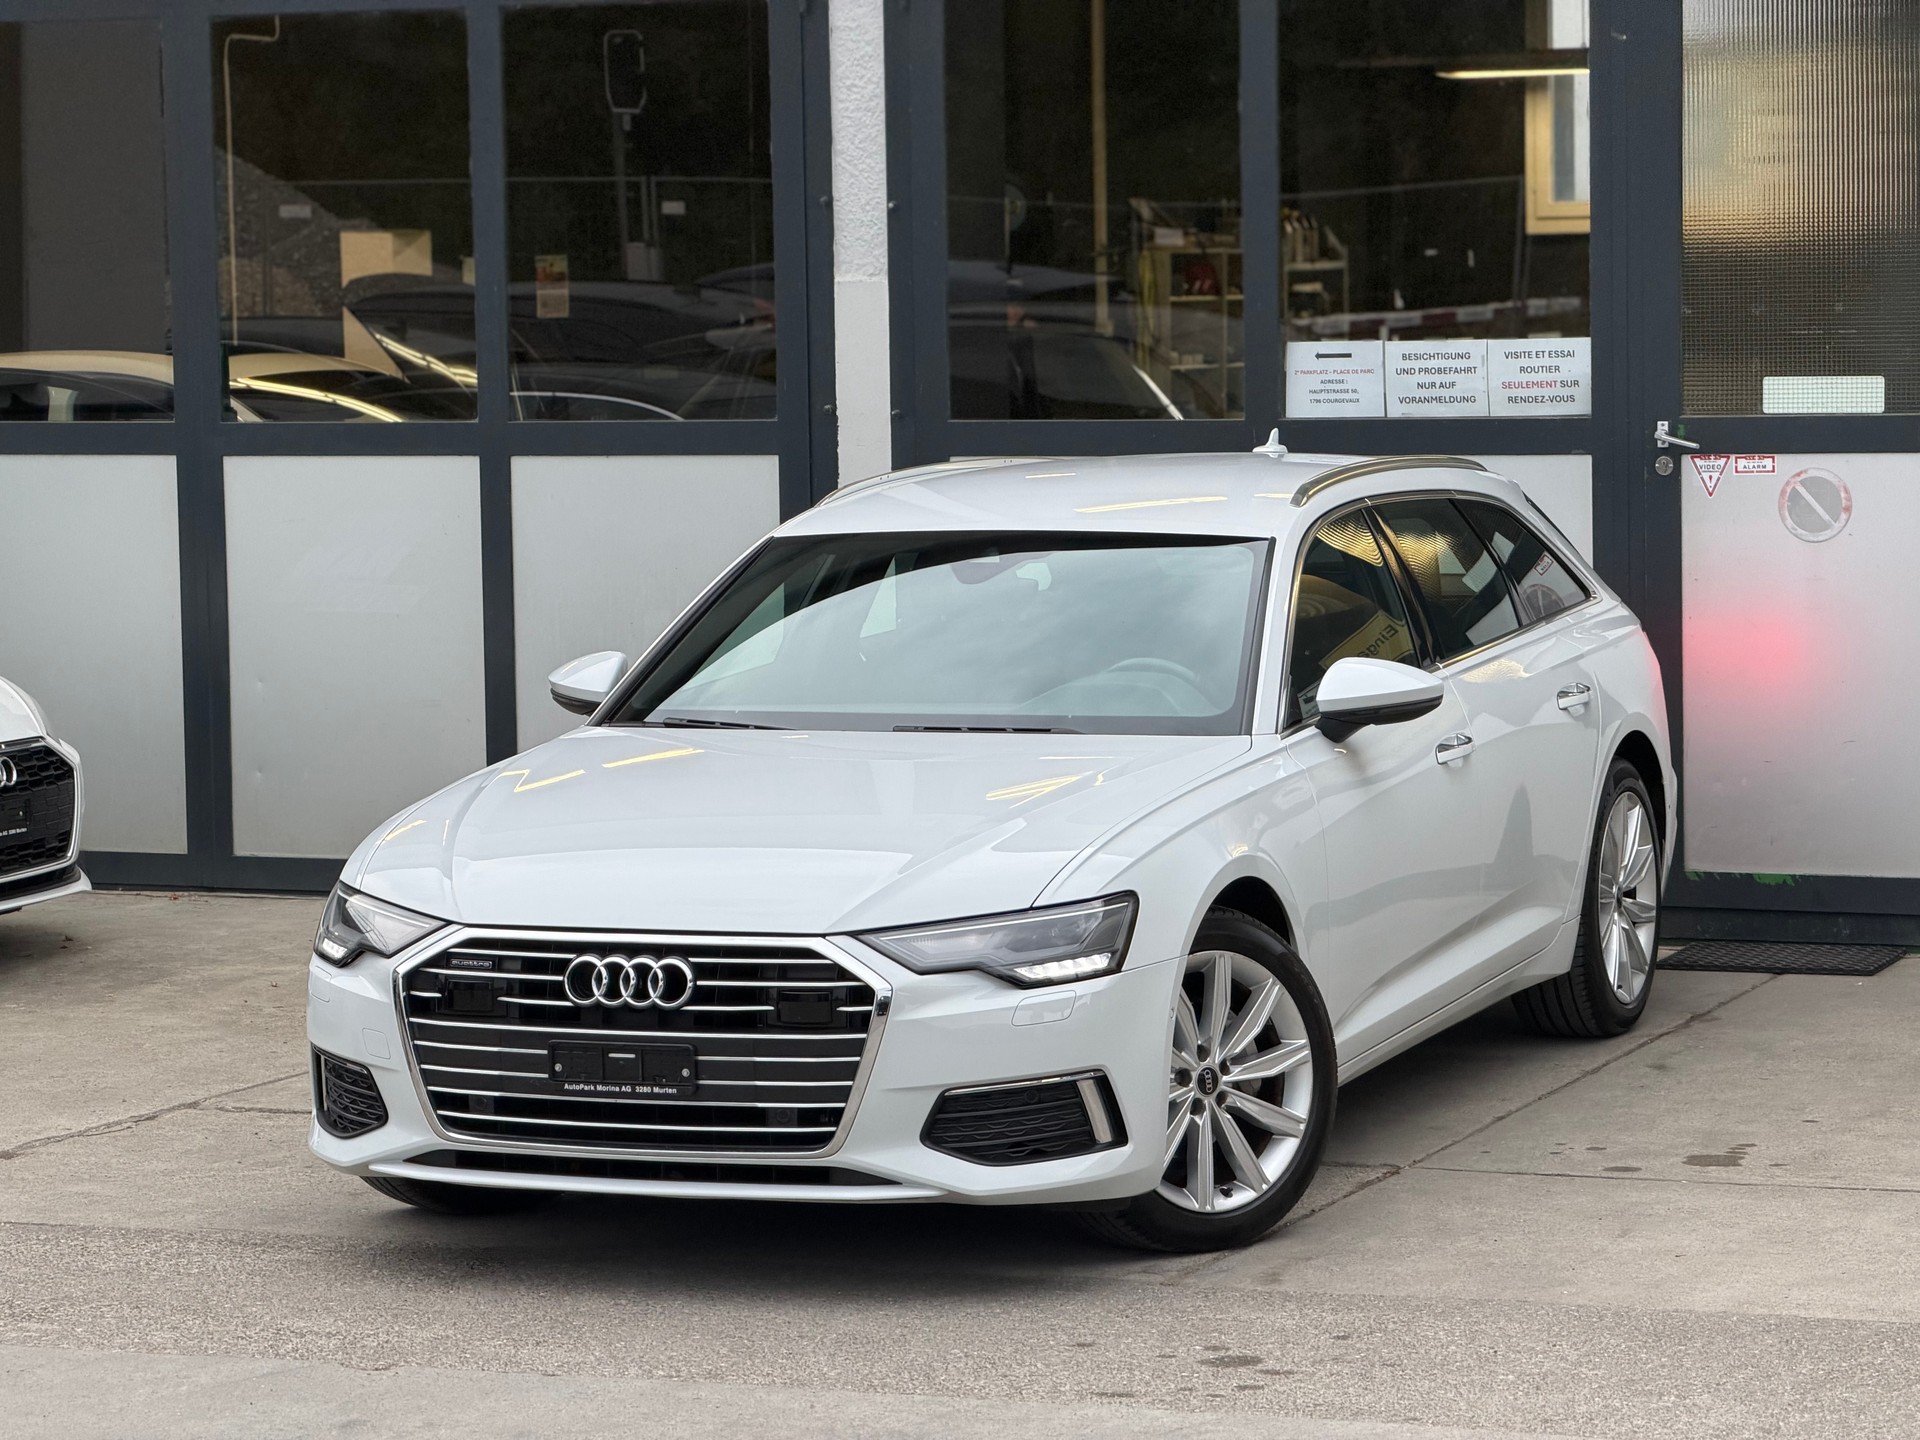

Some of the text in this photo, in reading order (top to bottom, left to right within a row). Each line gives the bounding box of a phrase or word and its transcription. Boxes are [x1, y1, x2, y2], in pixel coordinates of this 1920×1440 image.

[1401, 352, 1471, 361] BESICHTIGUNG
[1504, 350, 1575, 360] VISITE ET ESSAI
[1395, 366, 1478, 376] UND PROBEFAHRT
[1519, 365, 1561, 374] ROUTIER
[1416, 381, 1457, 390] NUR AUF
[1501, 379, 1580, 390] SEULEMENT SUR
[1398, 395, 1477, 404] VORANMELDUNG
[1507, 394, 1576, 404] RENDEZ-VOUS
[451, 960, 490, 968] quattro
[564, 1083, 595, 1091] AutoPark
[596, 1084, 620, 1092] Morina
[653, 1086, 677, 1094] Murten
